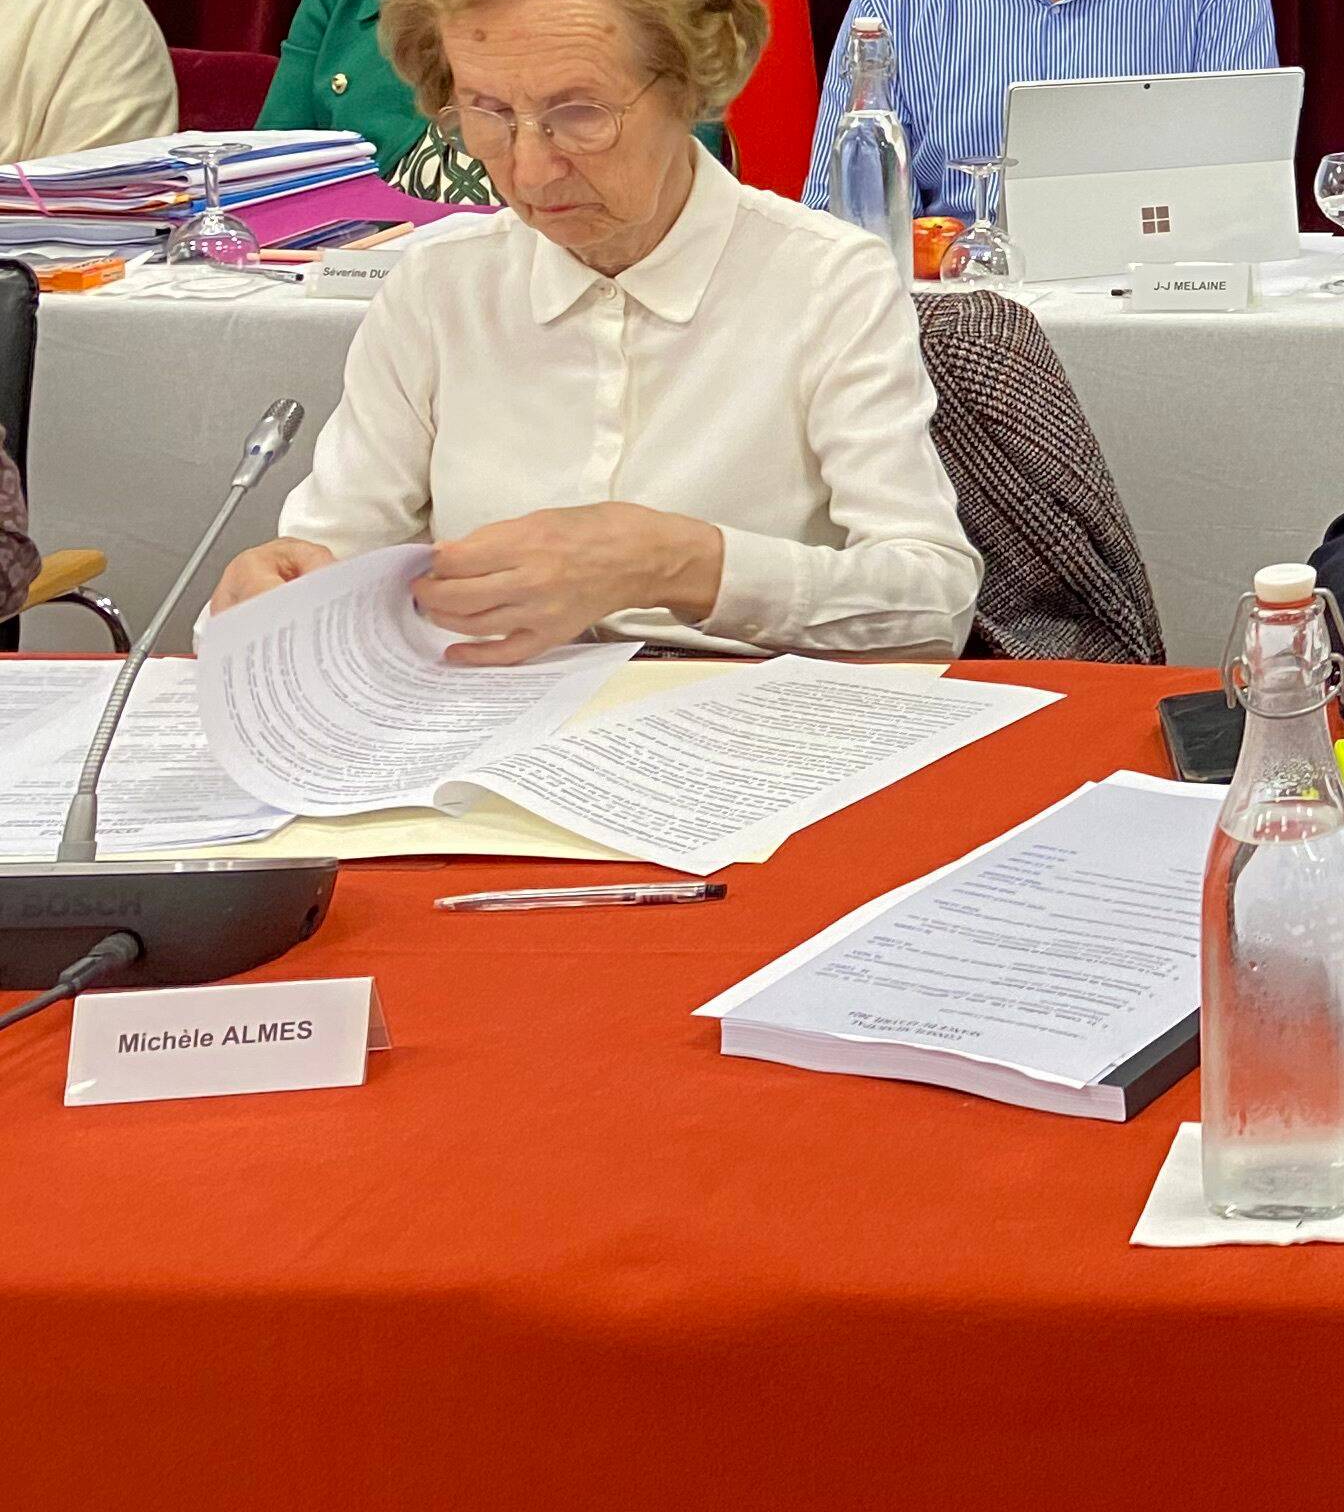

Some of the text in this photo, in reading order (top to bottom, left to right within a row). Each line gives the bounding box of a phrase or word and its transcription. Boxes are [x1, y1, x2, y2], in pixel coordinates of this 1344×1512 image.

[1153, 281, 1227, 291] J-J MELAINE
[22, 891, 144, 918] BOSCH
[118, 1020, 313, 1053] Michèle ALMES
